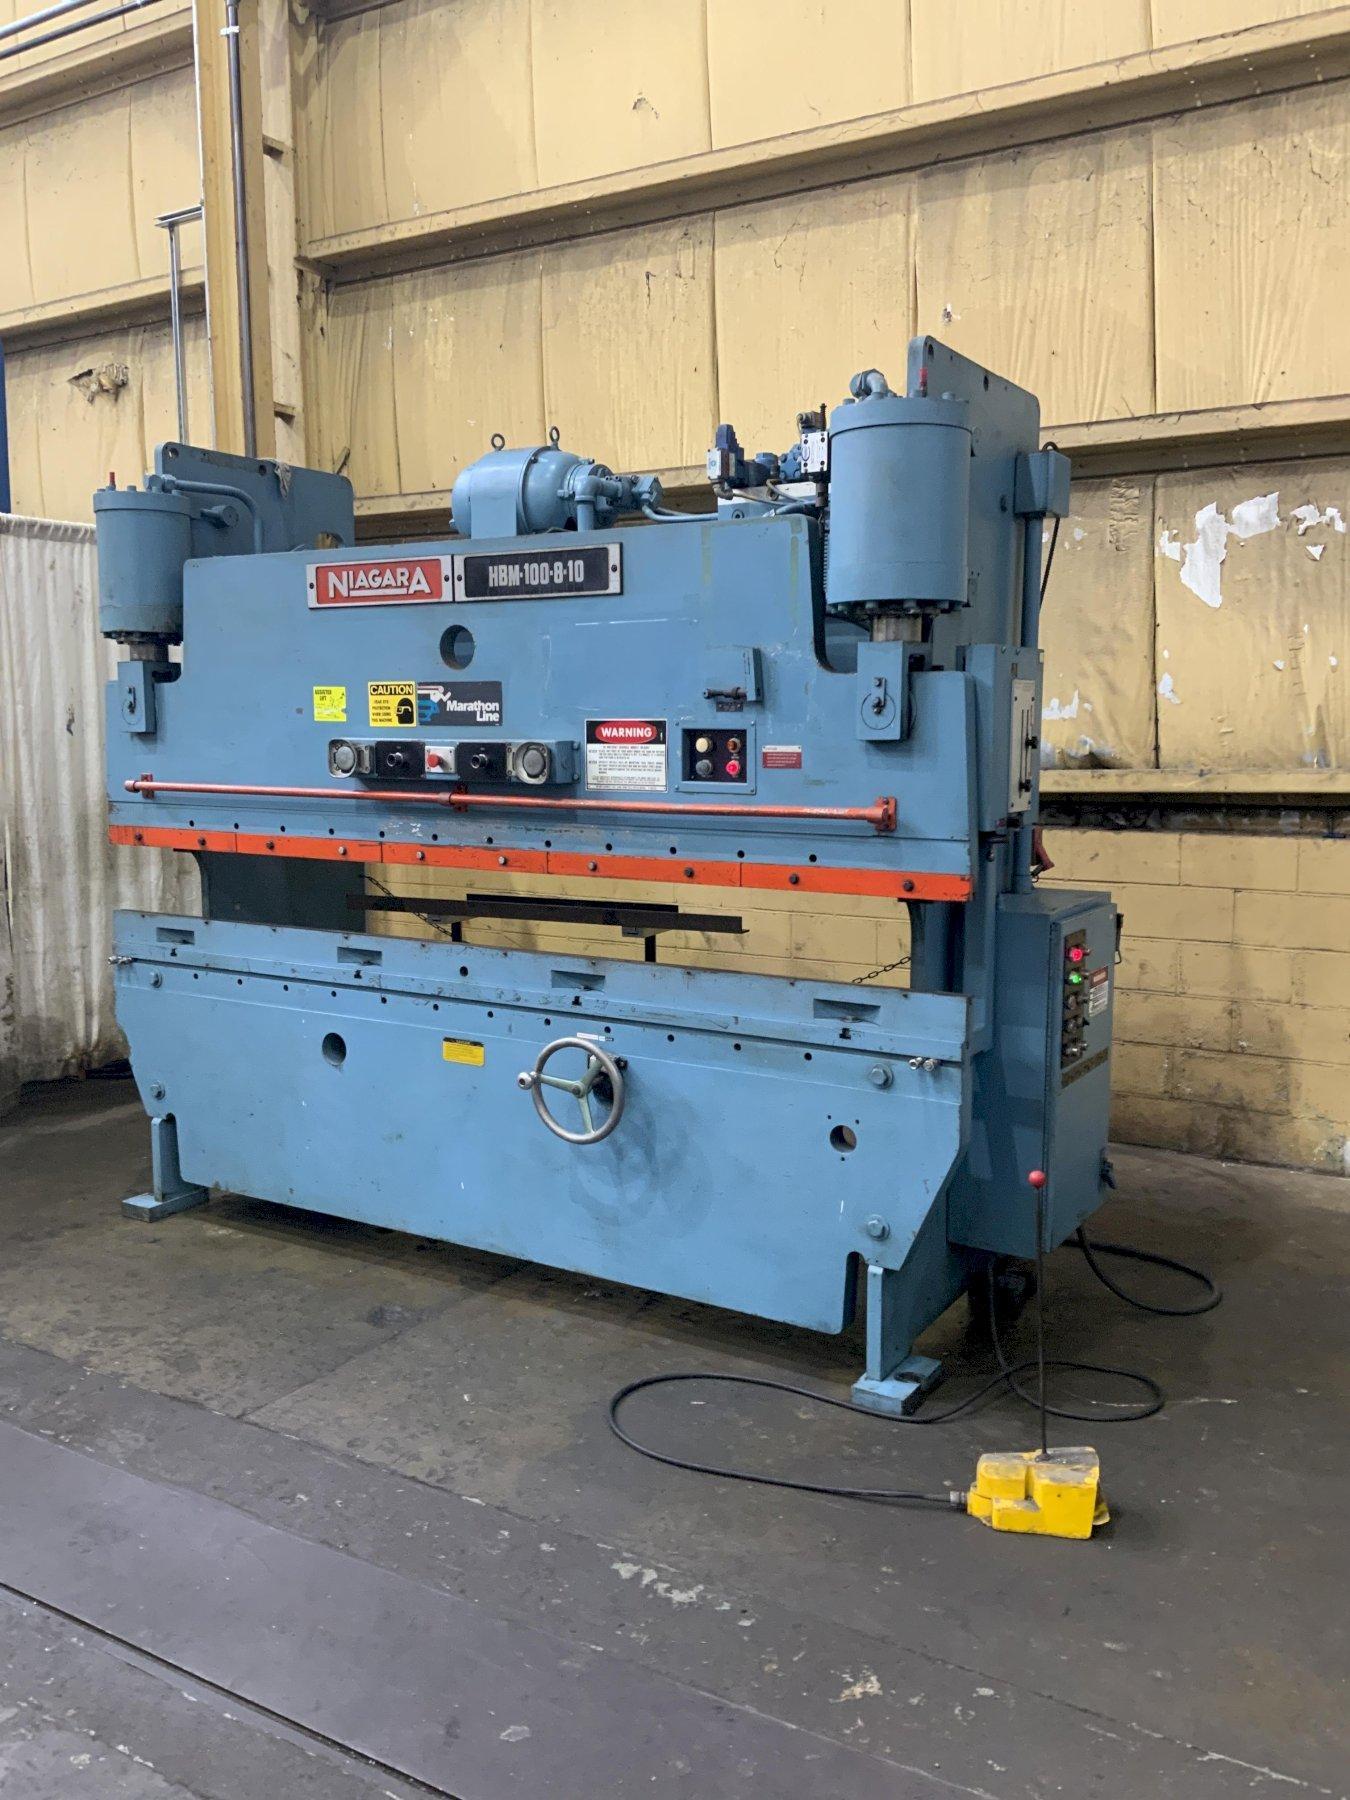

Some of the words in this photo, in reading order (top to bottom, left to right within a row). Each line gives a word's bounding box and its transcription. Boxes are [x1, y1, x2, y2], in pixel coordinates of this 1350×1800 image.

[328, 566, 431, 598] NIAGARA
[371, 686, 413, 694] CAUTION
[446, 700, 500, 711] Marathon
[476, 710, 500, 721] Line
[601, 727, 653, 738] WARNING
